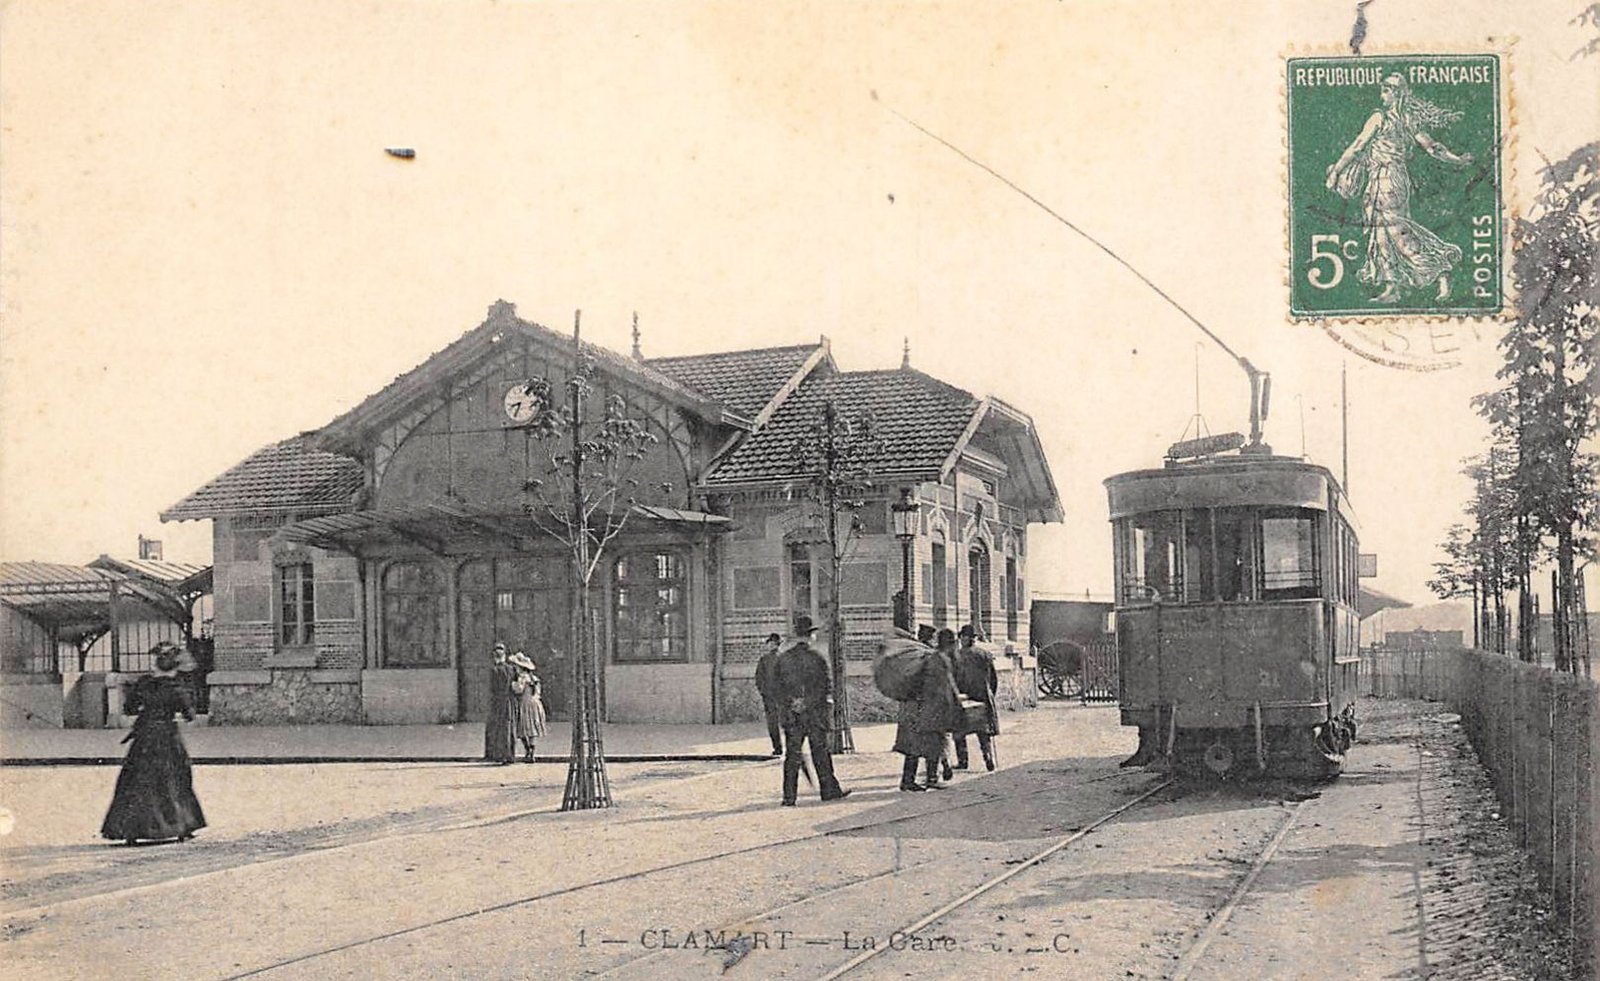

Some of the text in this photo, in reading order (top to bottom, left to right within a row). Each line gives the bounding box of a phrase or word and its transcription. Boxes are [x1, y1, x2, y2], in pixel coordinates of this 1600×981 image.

[1296, 65, 1490, 87] REPUBLIQUE FRANÇAISE
[1473, 214, 1492, 298] POSTES
